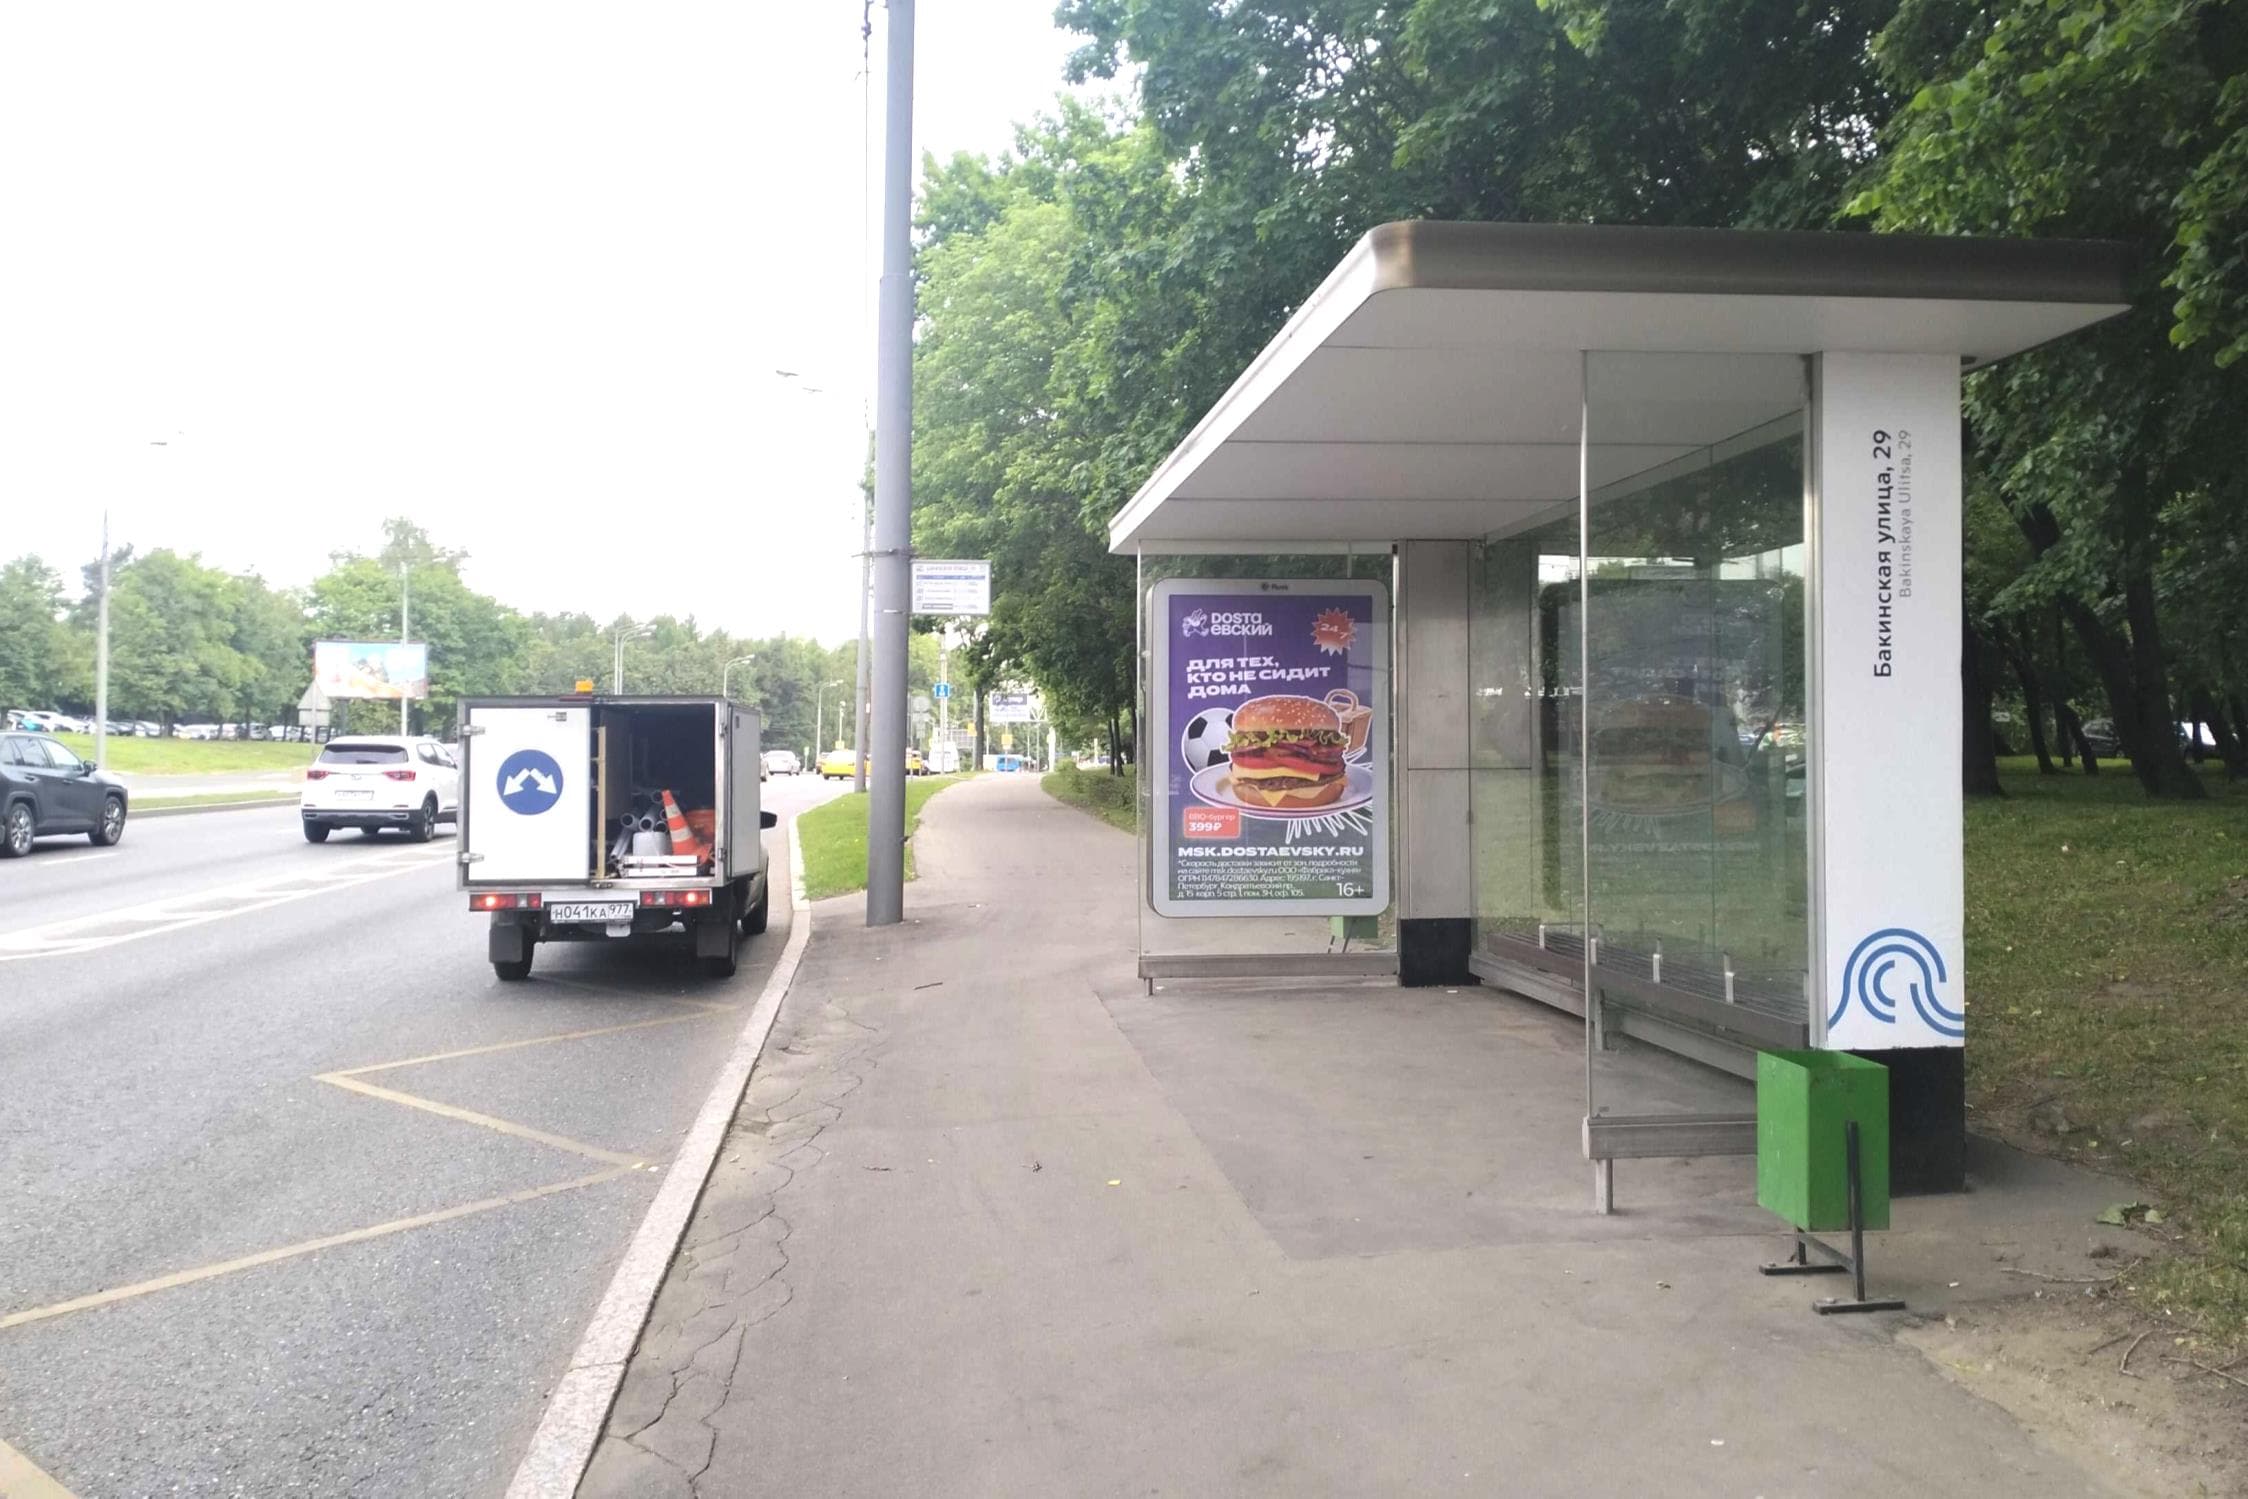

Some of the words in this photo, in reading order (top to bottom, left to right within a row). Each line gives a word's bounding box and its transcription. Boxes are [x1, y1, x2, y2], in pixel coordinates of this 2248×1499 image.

[1872, 429, 1892, 459] 29
[1898, 429, 1912, 449] 29
[1898, 453, 1913, 504] Ulitsa,
[1876, 465, 1895, 543] улица,
[1898, 508, 1914, 598] Bakinskaya
[1873, 550, 1892, 678] Бакинская
[1186, 658, 1234, 673] ДЛЯ
[1236, 656, 1280, 669] ТЕХ,
[1187, 671, 1227, 684] КТО
[1229, 670, 1256, 682] НЕ
[1258, 666, 1331, 682] СИДИТ
[1187, 684, 1252, 699] ДОМА
[1177, 846, 1364, 857] MSK.DOSTAEVSKY.RU
[1335, 882, 1365, 897] 16+
